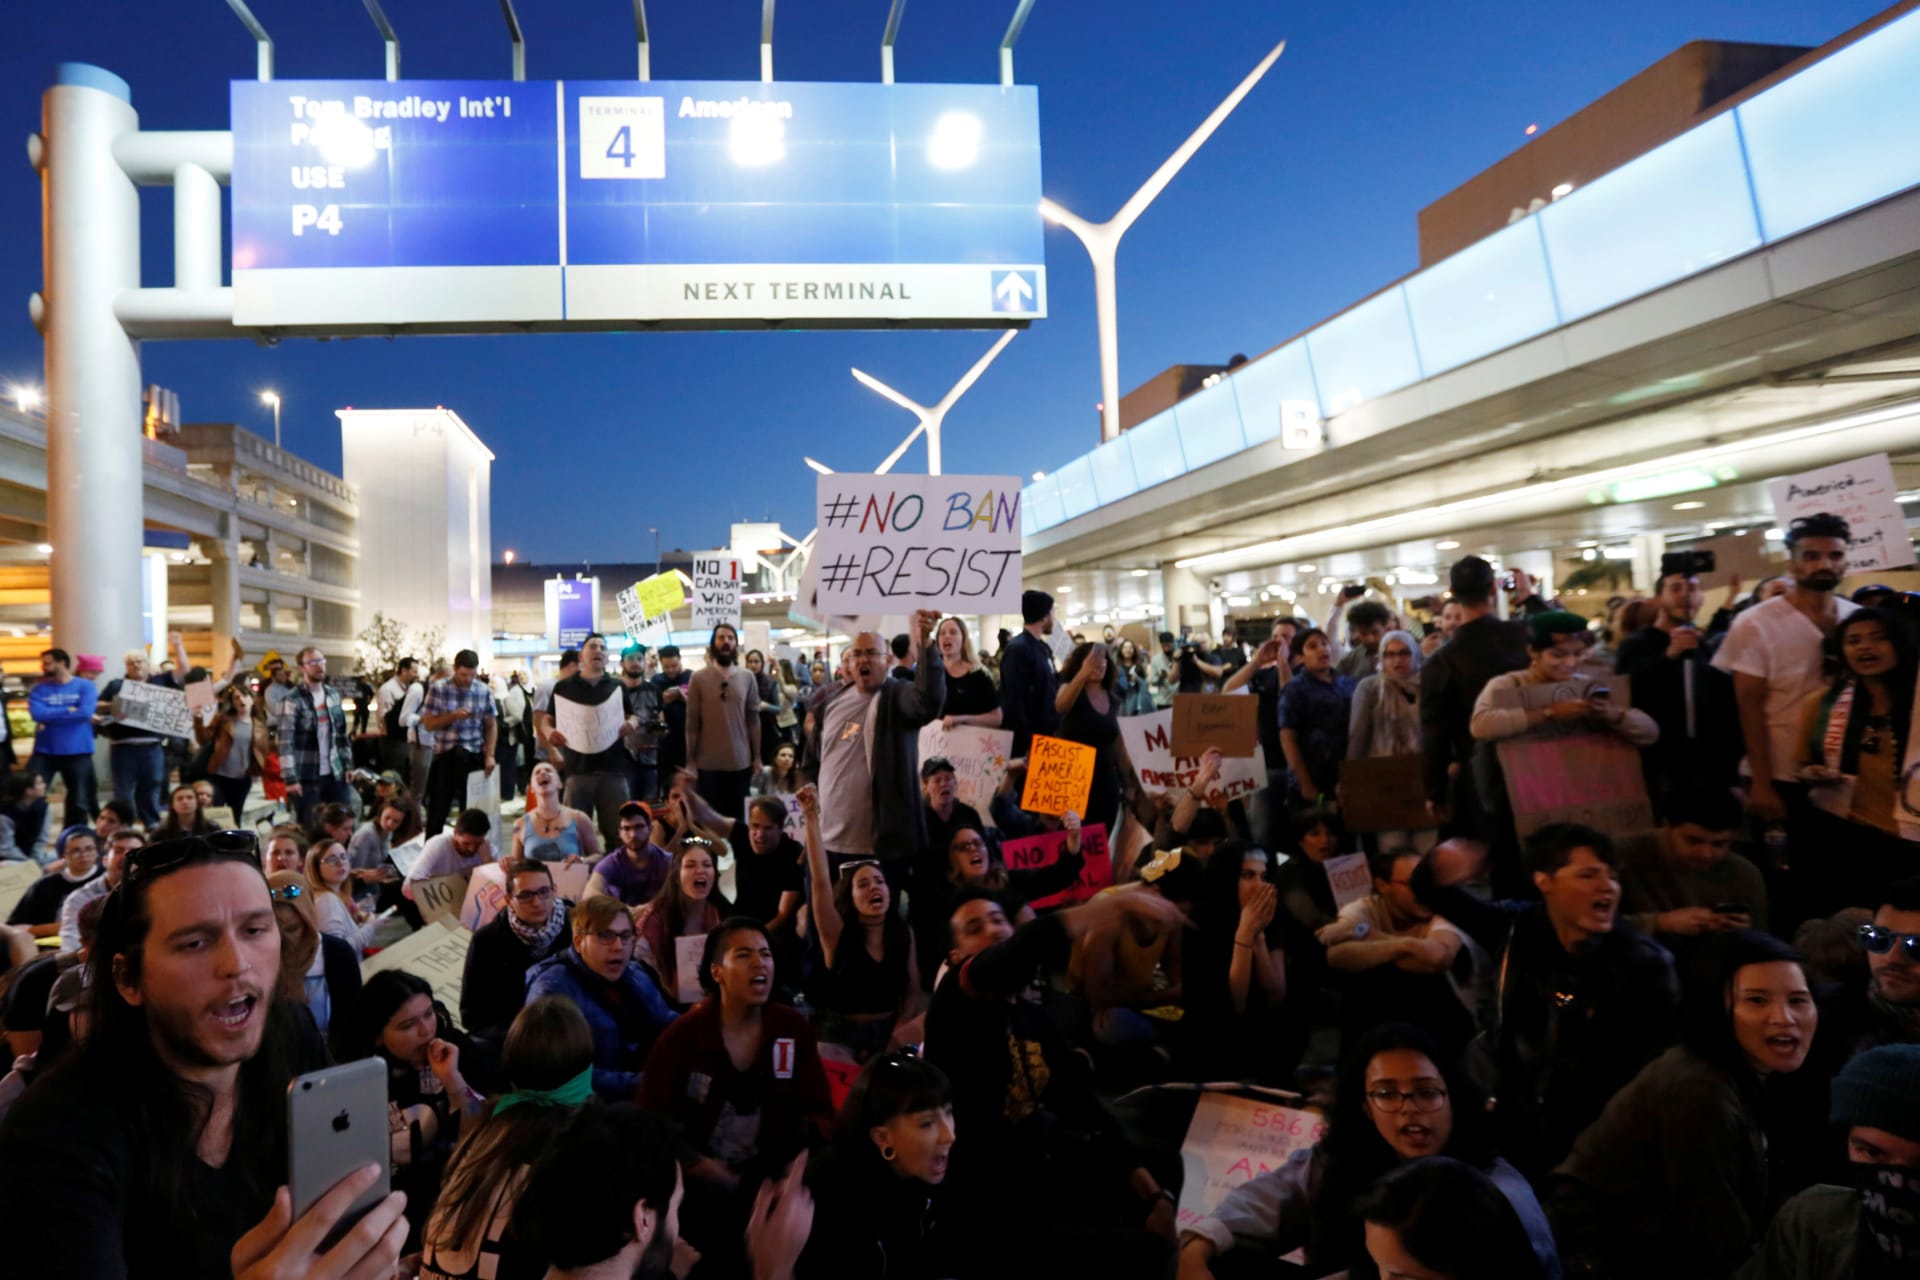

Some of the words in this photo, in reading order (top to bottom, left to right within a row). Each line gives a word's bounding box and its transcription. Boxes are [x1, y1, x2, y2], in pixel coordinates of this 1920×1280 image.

[354, 96, 450, 122] Bradley
[459, 96, 512, 118] Int'l
[606, 125, 637, 169] 4
[291, 166, 346, 189] USE
[291, 204, 344, 236] P4
[684, 281, 756, 301] NEXT
[769, 281, 912, 301] TERMINAL
[1280, 399, 1321, 450] B
[823, 490, 925, 534] #NO
[942, 489, 1021, 534] BAN
[696, 559, 720, 576] NO
[730, 560, 738, 581] 1
[821, 545, 1022, 598] #RESIST
[701, 592, 735, 605] WHO
[1034, 737, 1084, 762] FASCIST
[1029, 778, 1041, 790] IS
[1043, 779, 1073, 793] NOT
[1012, 845, 1044, 867] NO
[422, 881, 454, 910] NO
